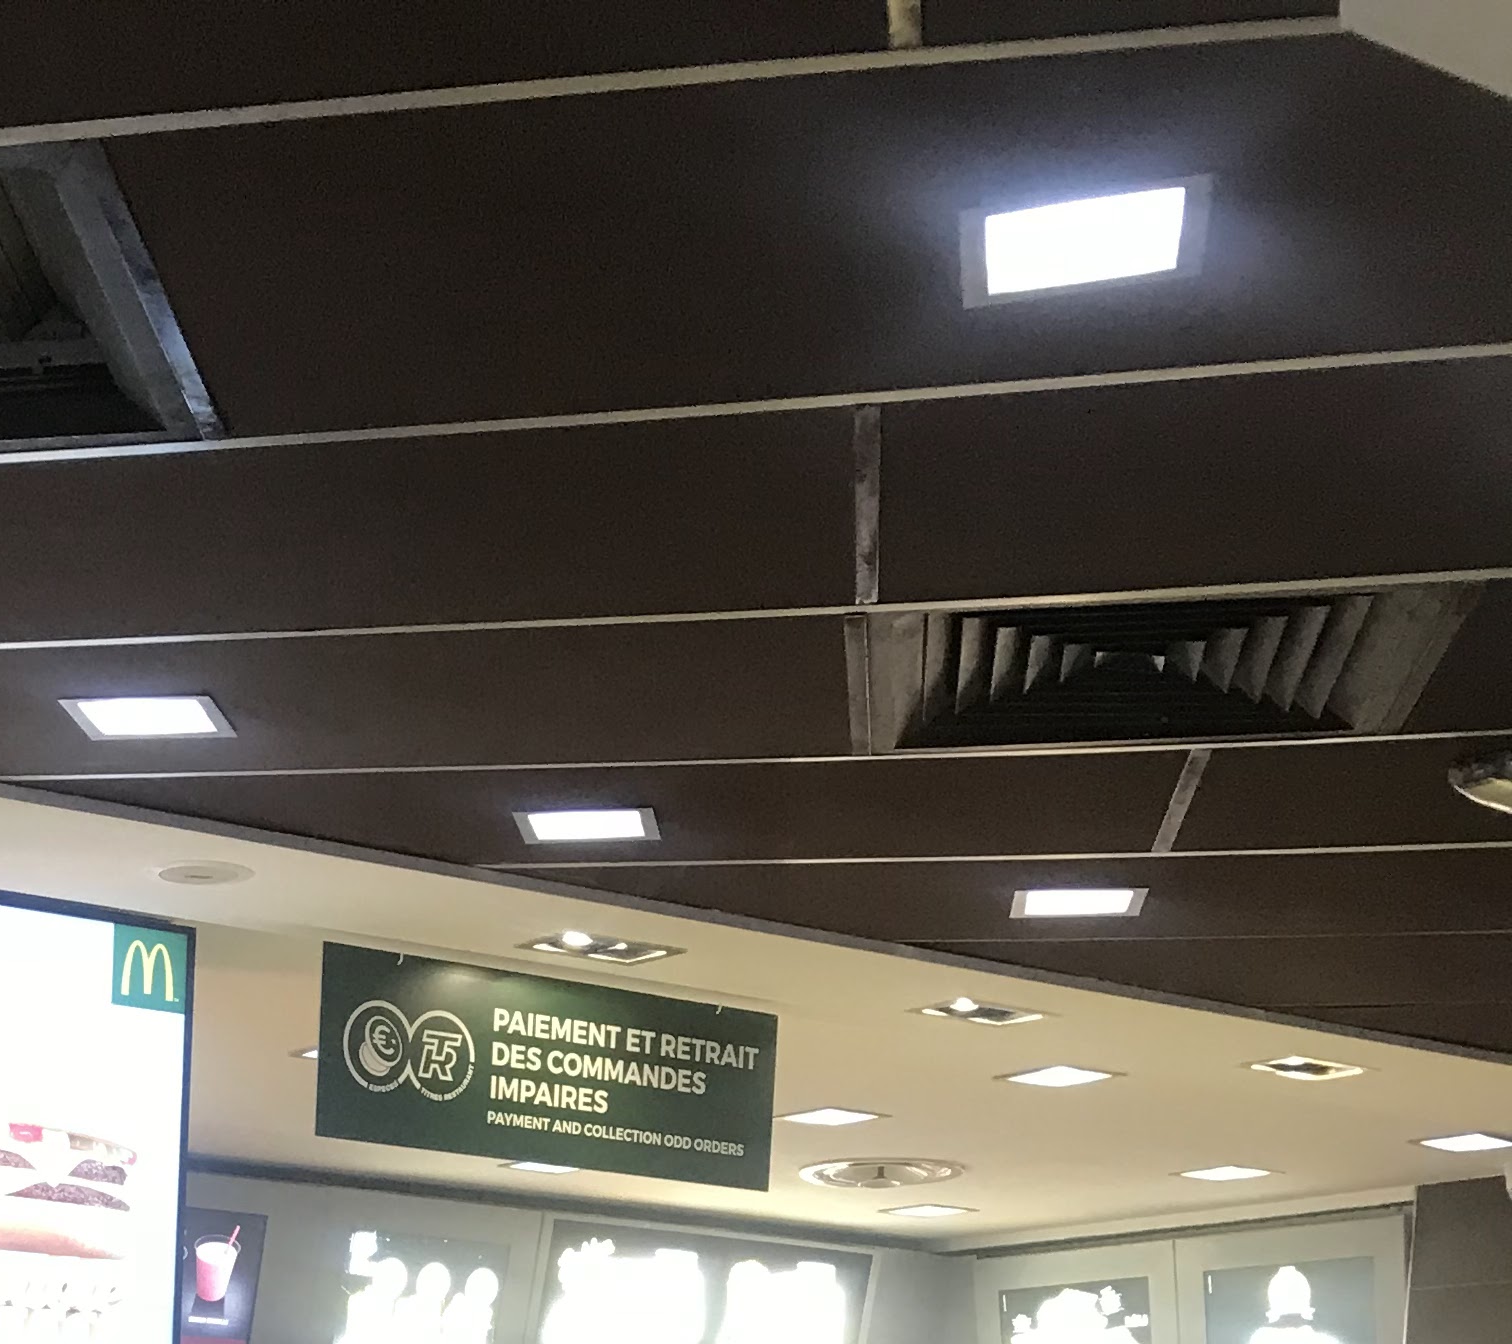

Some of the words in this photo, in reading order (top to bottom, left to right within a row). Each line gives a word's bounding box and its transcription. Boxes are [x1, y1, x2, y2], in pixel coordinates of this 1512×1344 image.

[493, 1007, 622, 1049] PAIEMENT
[626, 1028, 656, 1054] ET
[660, 1033, 759, 1070] RETRAIT
[491, 1041, 542, 1072] DES
[547, 1050, 706, 1095] COMMANDES
[490, 1075, 609, 1114] IMPAIRES
[487, 1111, 551, 1131] PAYMENT
[552, 1119, 582, 1135] AND
[583, 1123, 661, 1146] COLLECTION
[664, 1134, 692, 1150] ODD
[694, 1138, 745, 1157] ORDERS
